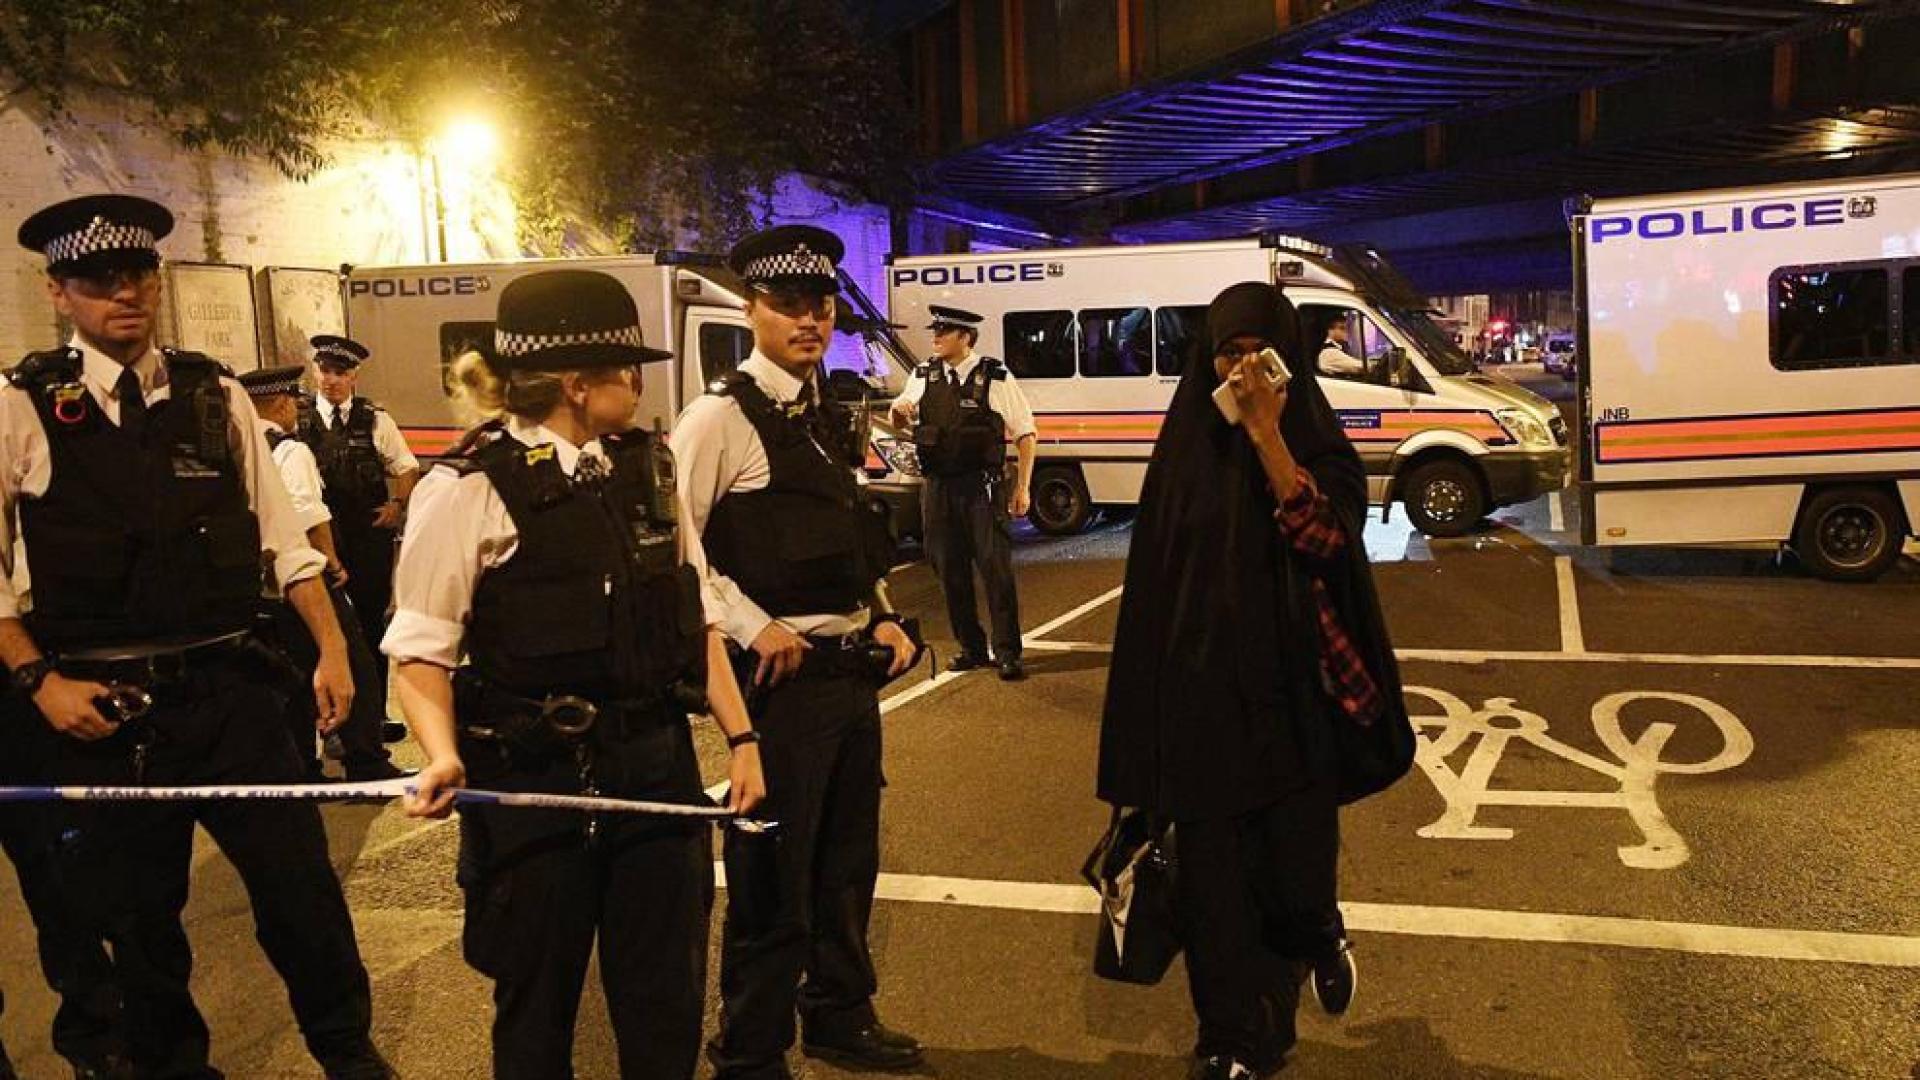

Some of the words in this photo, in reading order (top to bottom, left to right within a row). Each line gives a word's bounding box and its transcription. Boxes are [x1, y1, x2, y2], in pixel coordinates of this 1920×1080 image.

[1592, 199, 1844, 243] POLICE
[893, 263, 1044, 287] POLICE
[350, 276, 475, 297] POLICE
[1598, 407, 1630, 421] JNB
